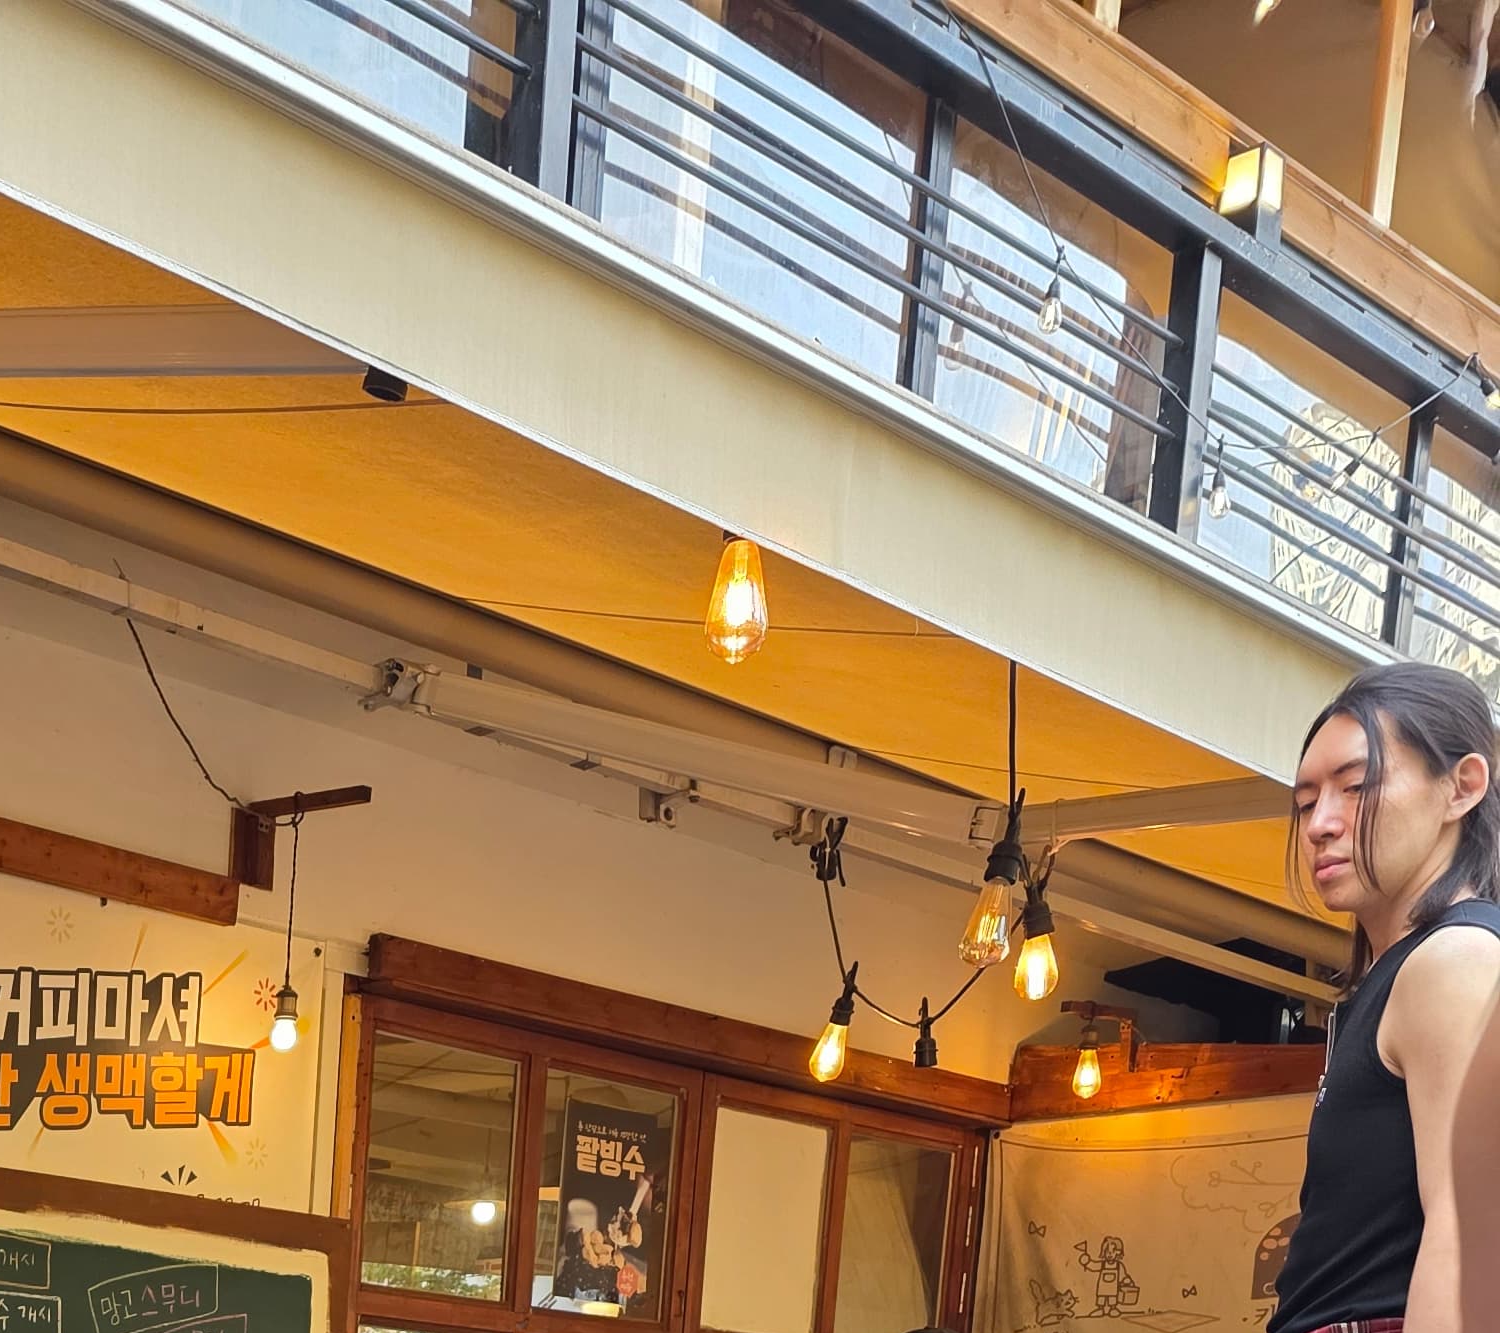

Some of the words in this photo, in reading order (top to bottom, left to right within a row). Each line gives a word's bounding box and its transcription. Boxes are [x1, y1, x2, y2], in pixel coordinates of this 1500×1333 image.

[35, 1051, 255, 1128] 생맥할게
[576, 1134, 646, 1181] 팥빙수
[0, 1248, 36, 1272] 개시
[17, 1304, 51, 1324] 개시
